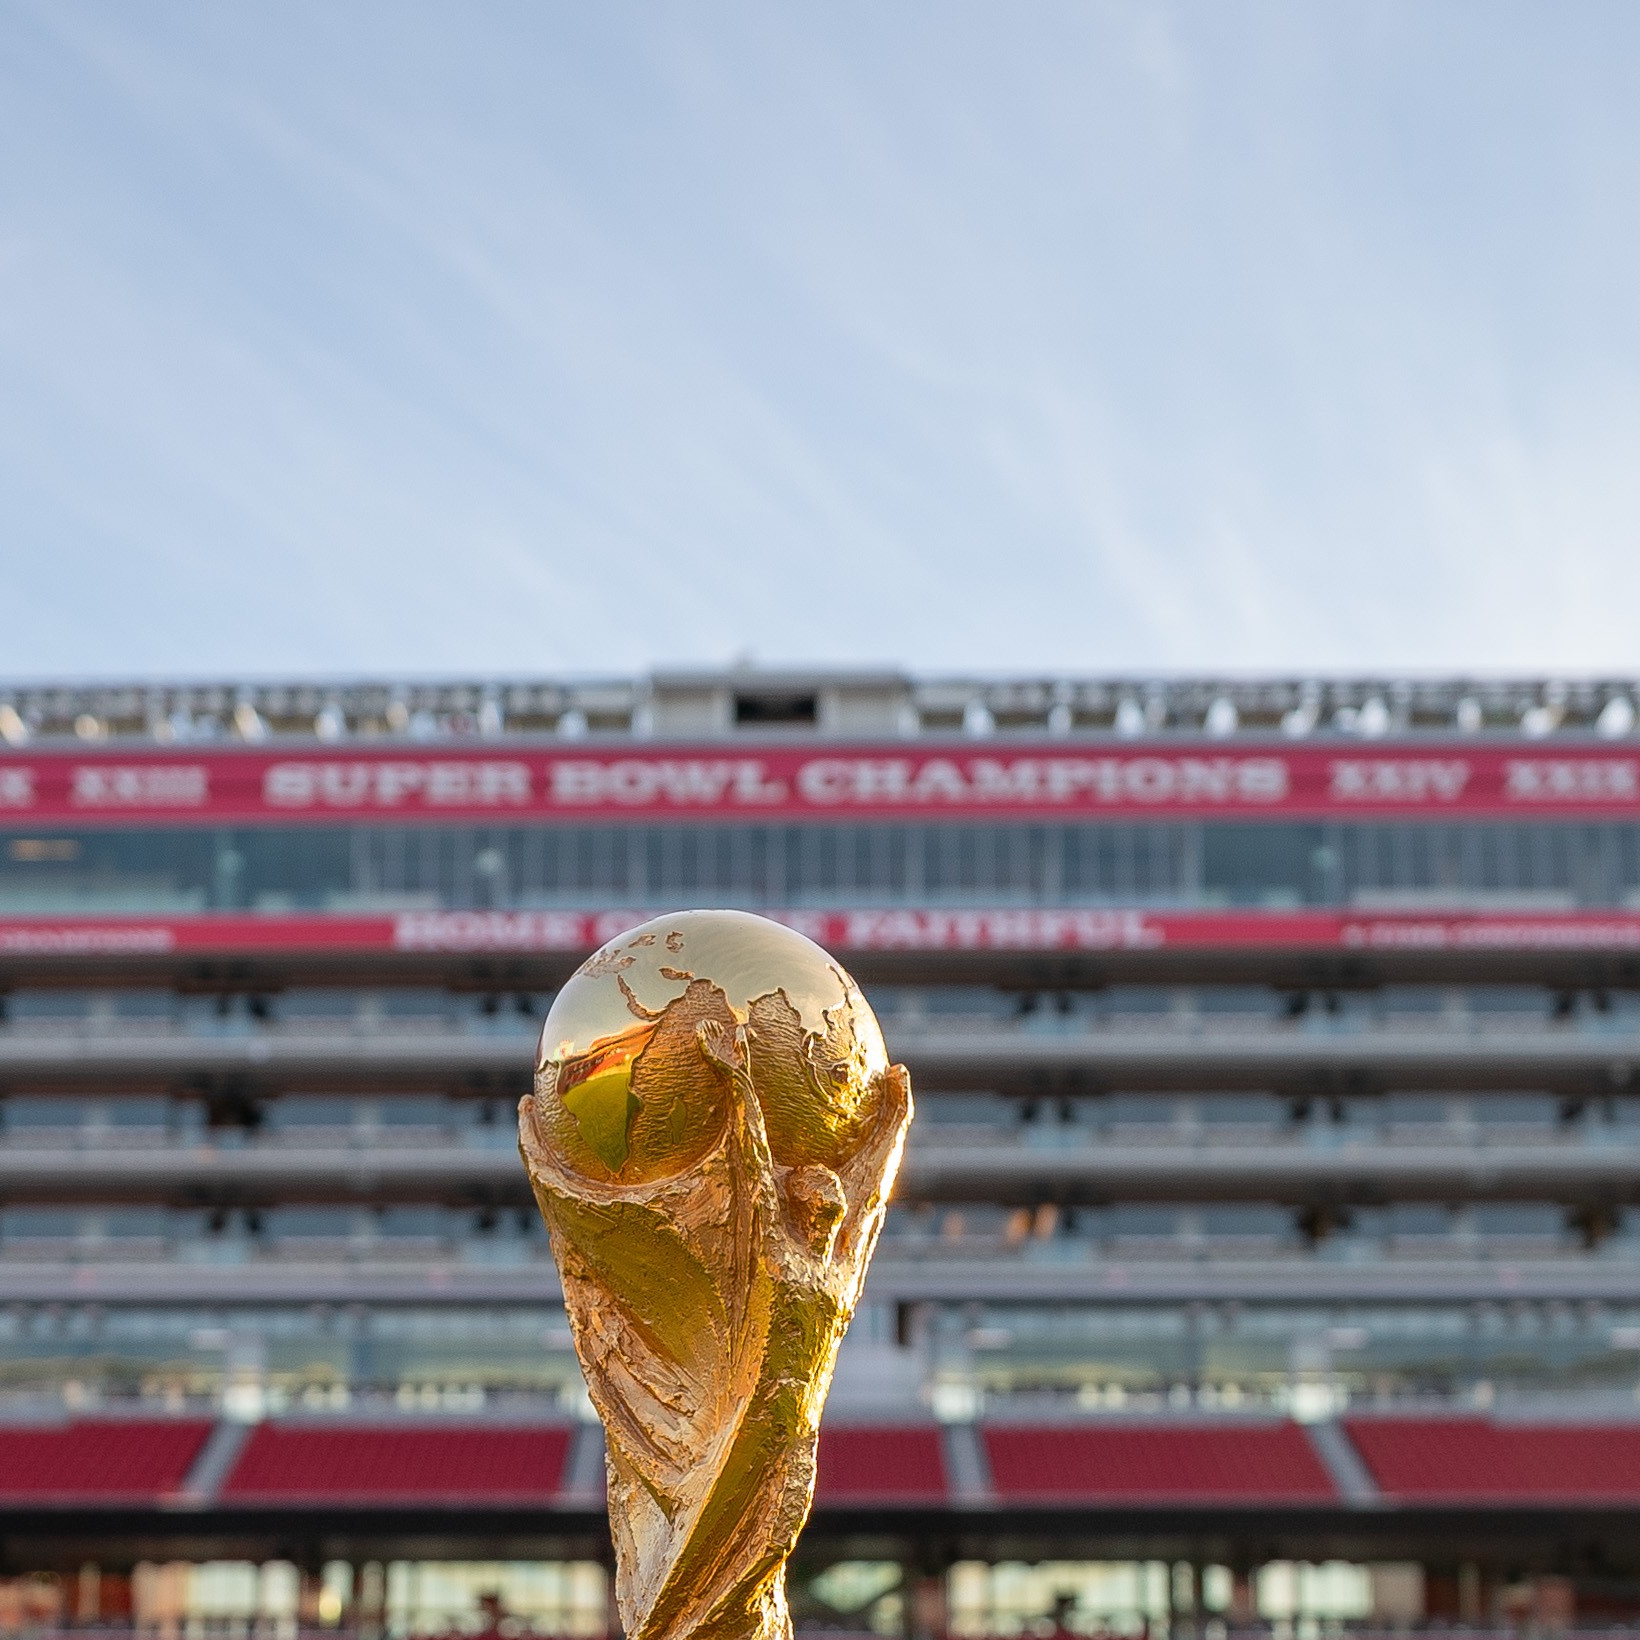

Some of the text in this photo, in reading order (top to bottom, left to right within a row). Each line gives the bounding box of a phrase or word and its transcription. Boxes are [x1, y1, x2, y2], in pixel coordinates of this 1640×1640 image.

[266, 761, 532, 803] SUPER
[551, 760, 787, 802] BOWL
[801, 760, 1288, 802] CHAMPIONS
[394, 912, 579, 949] HOME
[845, 910, 1163, 949] FAITHFUL
